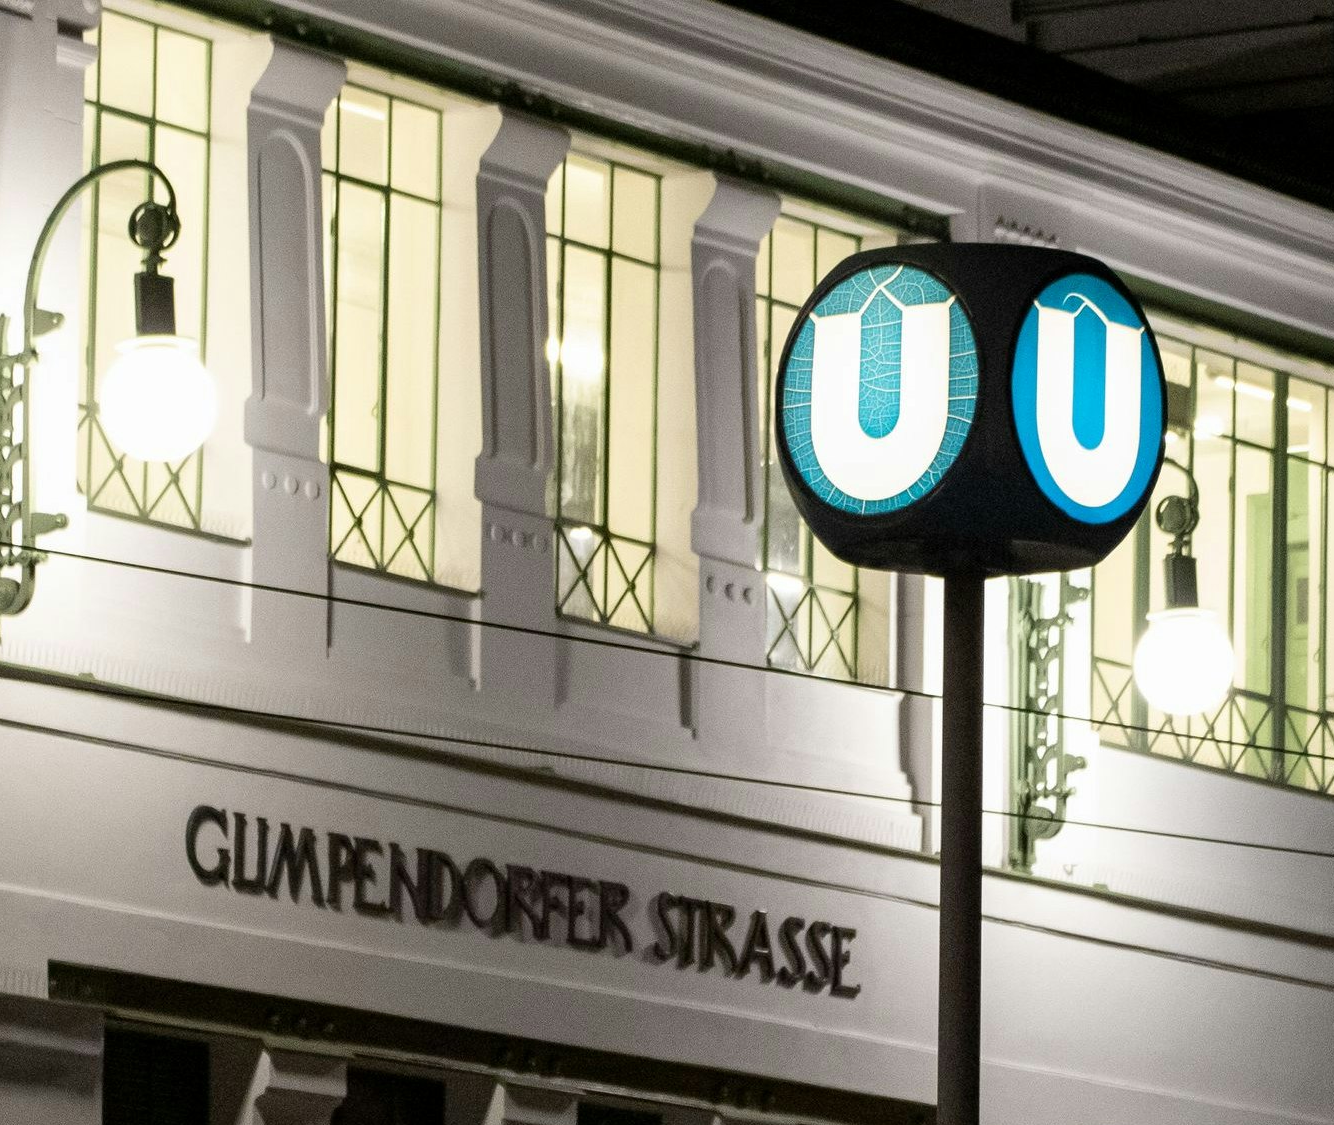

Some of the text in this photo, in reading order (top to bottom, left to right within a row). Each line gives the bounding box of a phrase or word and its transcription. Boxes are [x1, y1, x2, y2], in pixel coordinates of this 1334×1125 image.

[810, 303, 952, 501] U
[1035, 306, 1143, 508] U
[185, 804, 862, 999] GUMPENDORFER STRASSE
